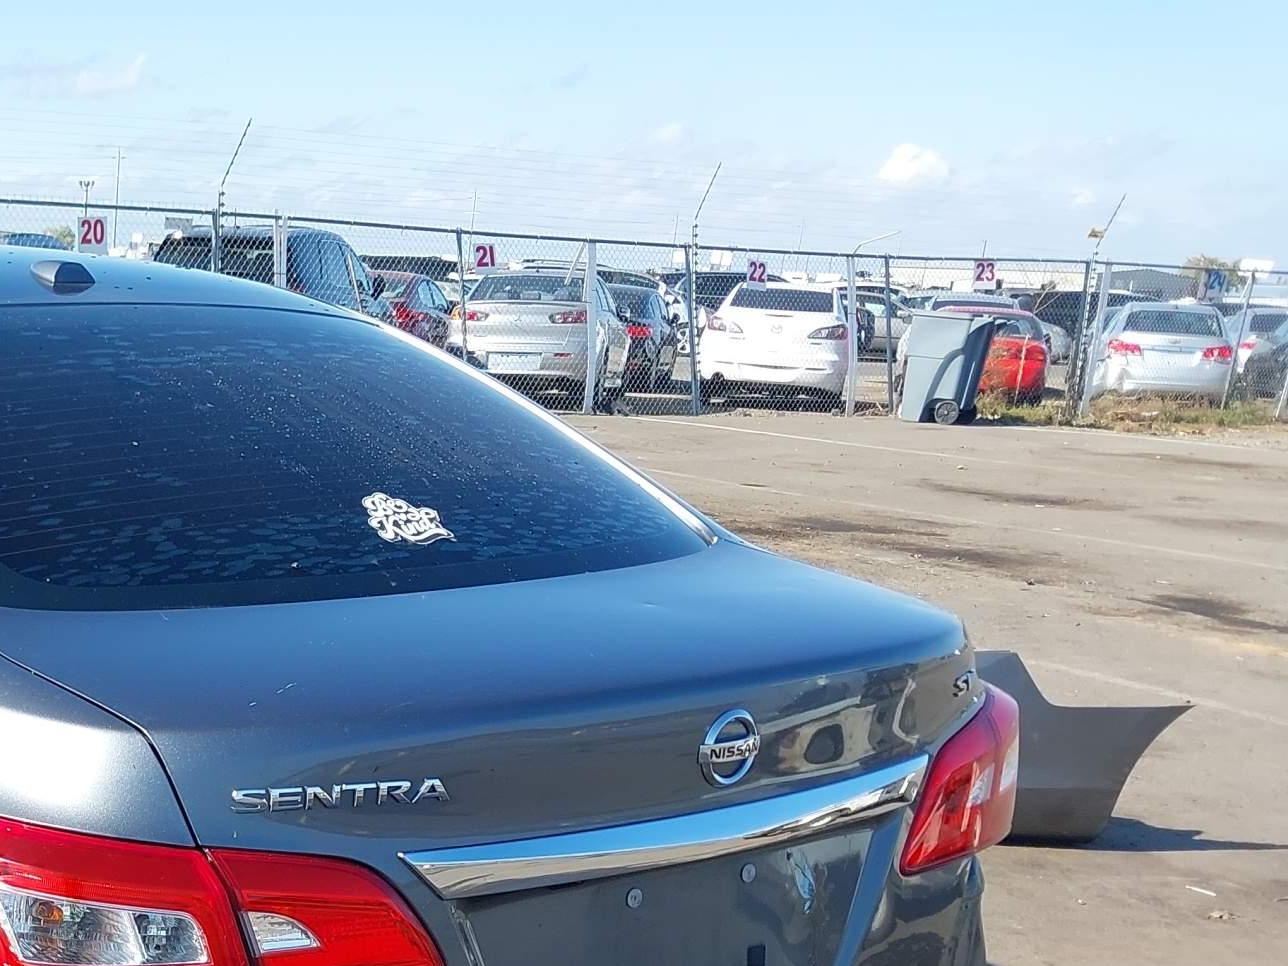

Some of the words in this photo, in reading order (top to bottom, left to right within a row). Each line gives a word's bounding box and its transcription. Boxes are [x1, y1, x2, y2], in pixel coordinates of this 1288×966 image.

[80, 218, 105, 245] 20
[475, 245, 496, 268] 21
[749, 262, 766, 283] 22
[975, 262, 995, 282] 23
[710, 739, 758, 759] NISSAN
[230, 776, 451, 814] SENTRA
